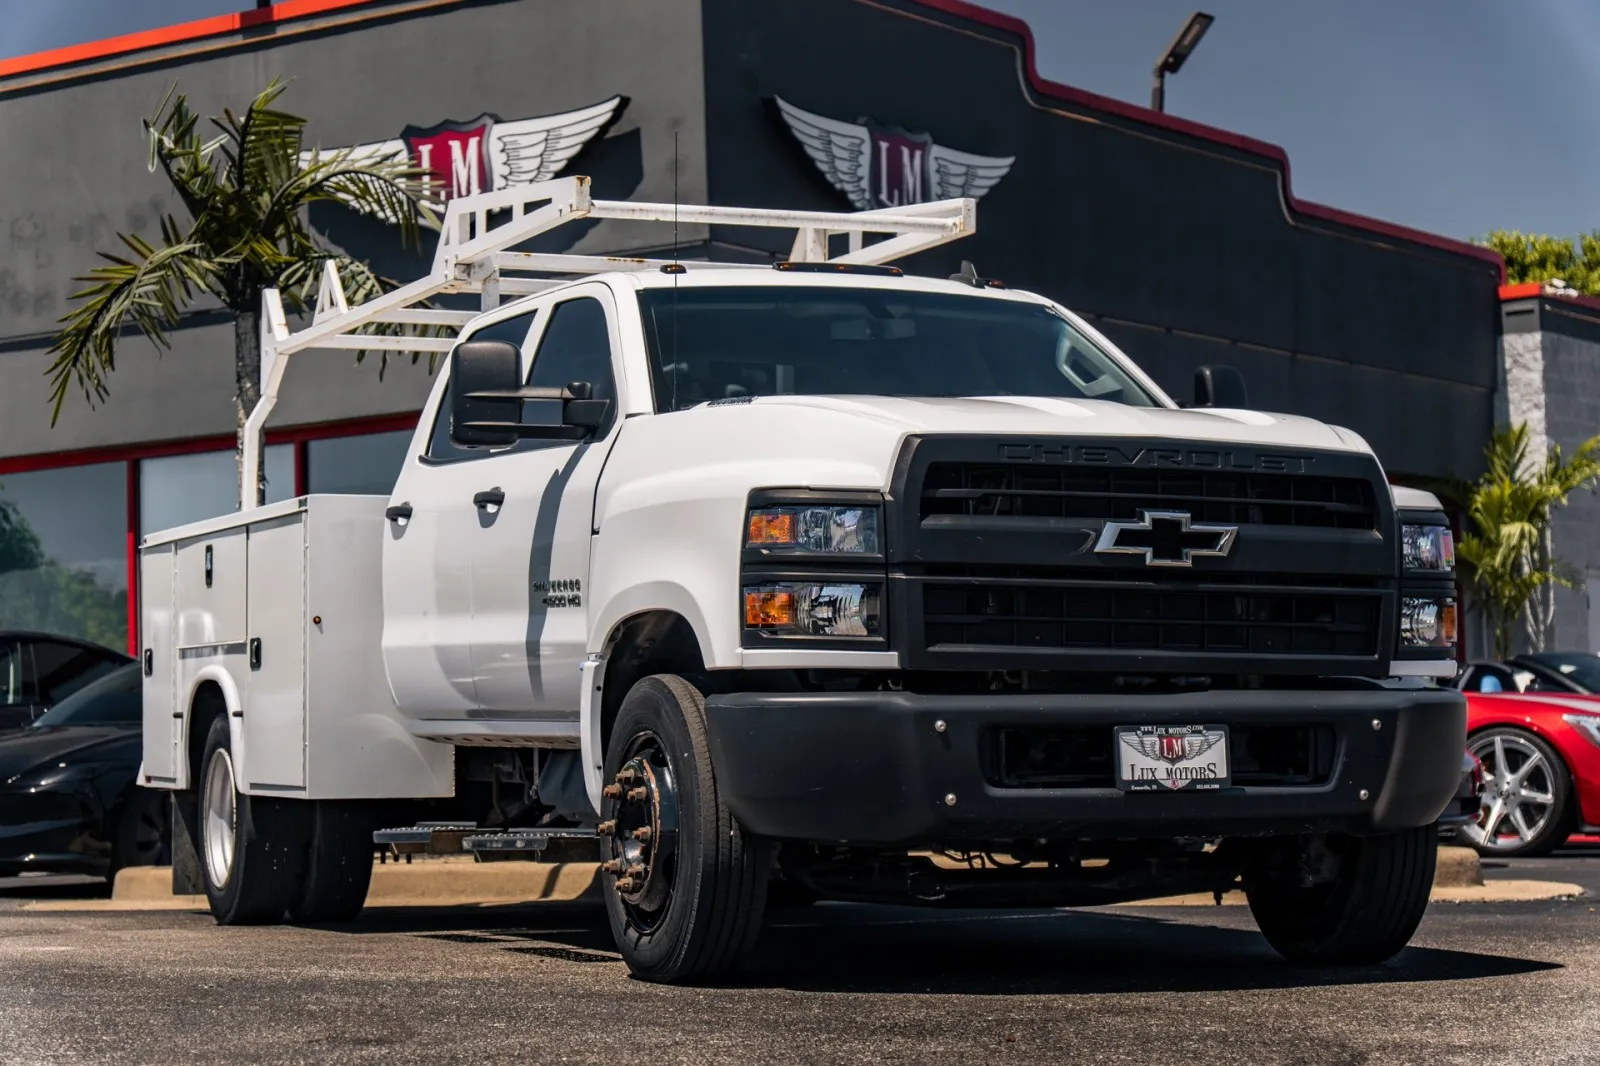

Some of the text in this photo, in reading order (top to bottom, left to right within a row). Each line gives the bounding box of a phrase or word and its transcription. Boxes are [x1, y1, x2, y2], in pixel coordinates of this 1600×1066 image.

[878, 140, 923, 207] LM
[997, 443, 1316, 473] CHEVROLET
[1162, 739, 1183, 759] LM
[1129, 762, 1217, 781] LUX MOTORS
